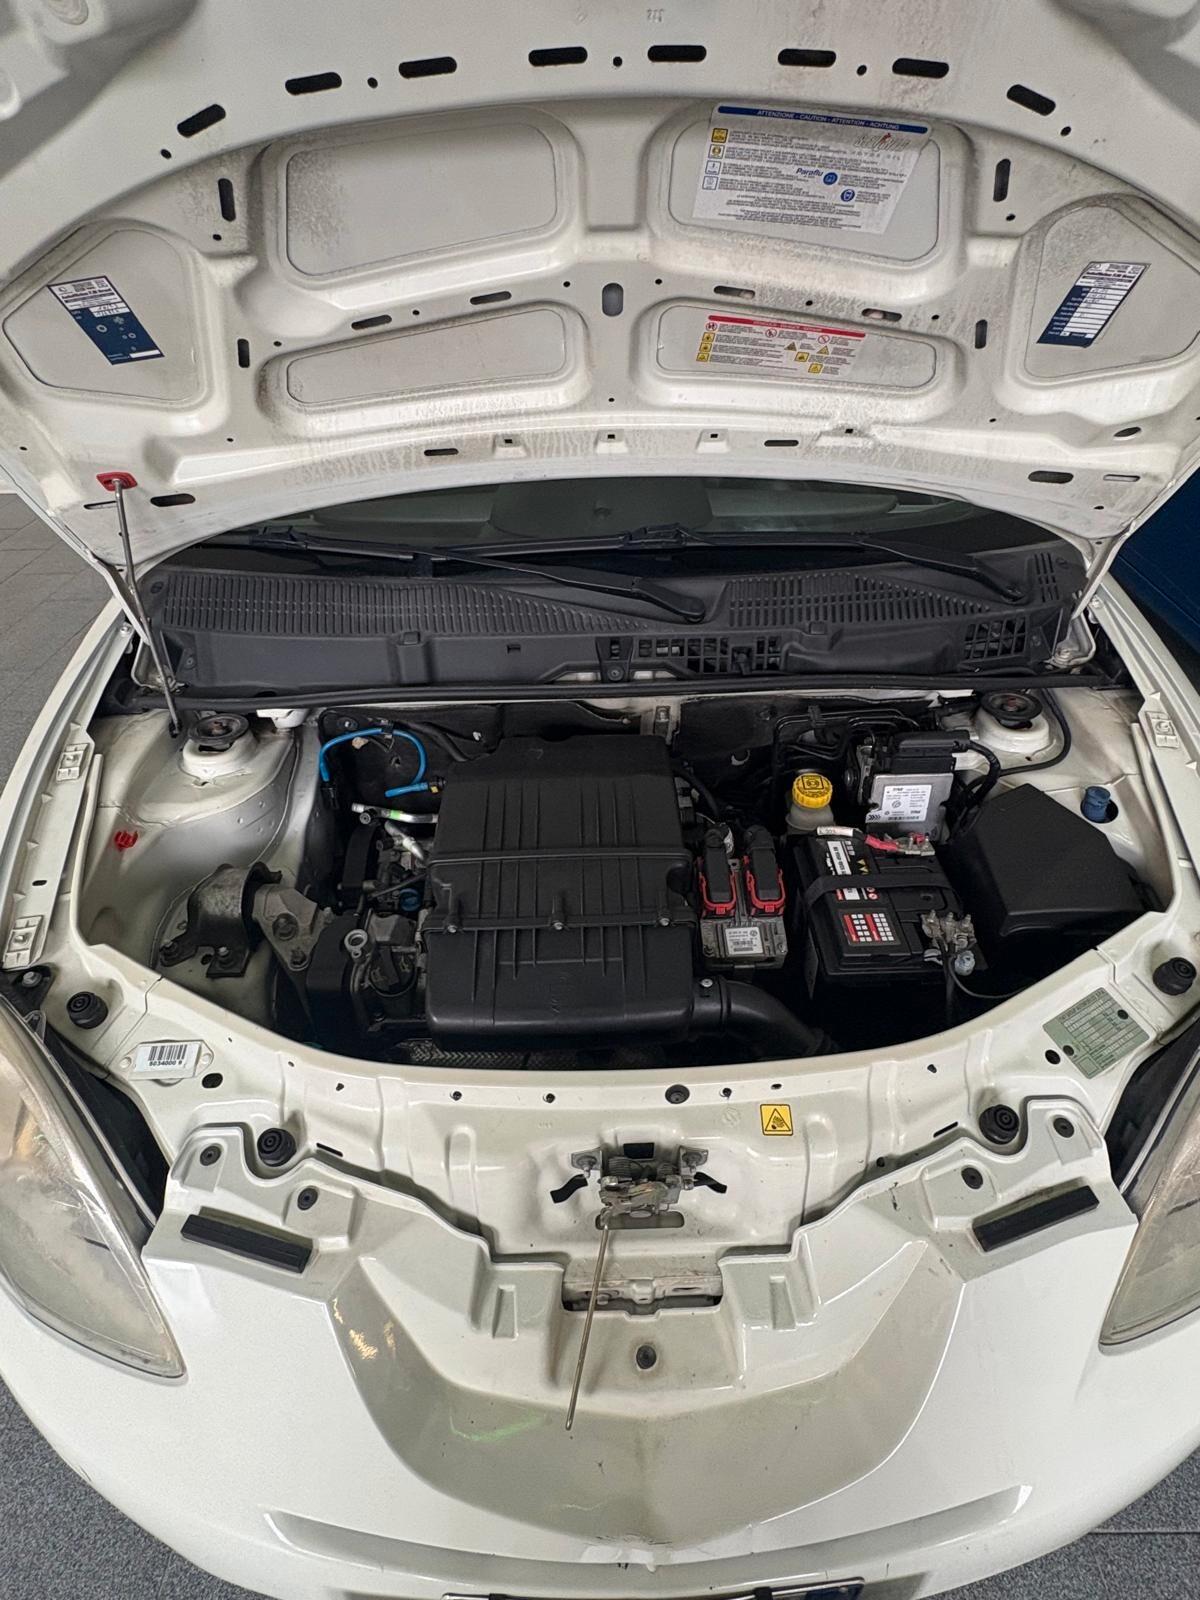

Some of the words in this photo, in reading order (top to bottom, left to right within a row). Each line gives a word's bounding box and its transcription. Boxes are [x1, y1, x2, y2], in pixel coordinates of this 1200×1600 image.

[757, 110, 795, 120] ATTENZIONE
[799, 114, 827, 122] CAUTION
[832, 117, 865, 126] ATTENTION
[870, 121, 900, 130] ACHTUNG
[796, 167, 824, 177] Paraflu
